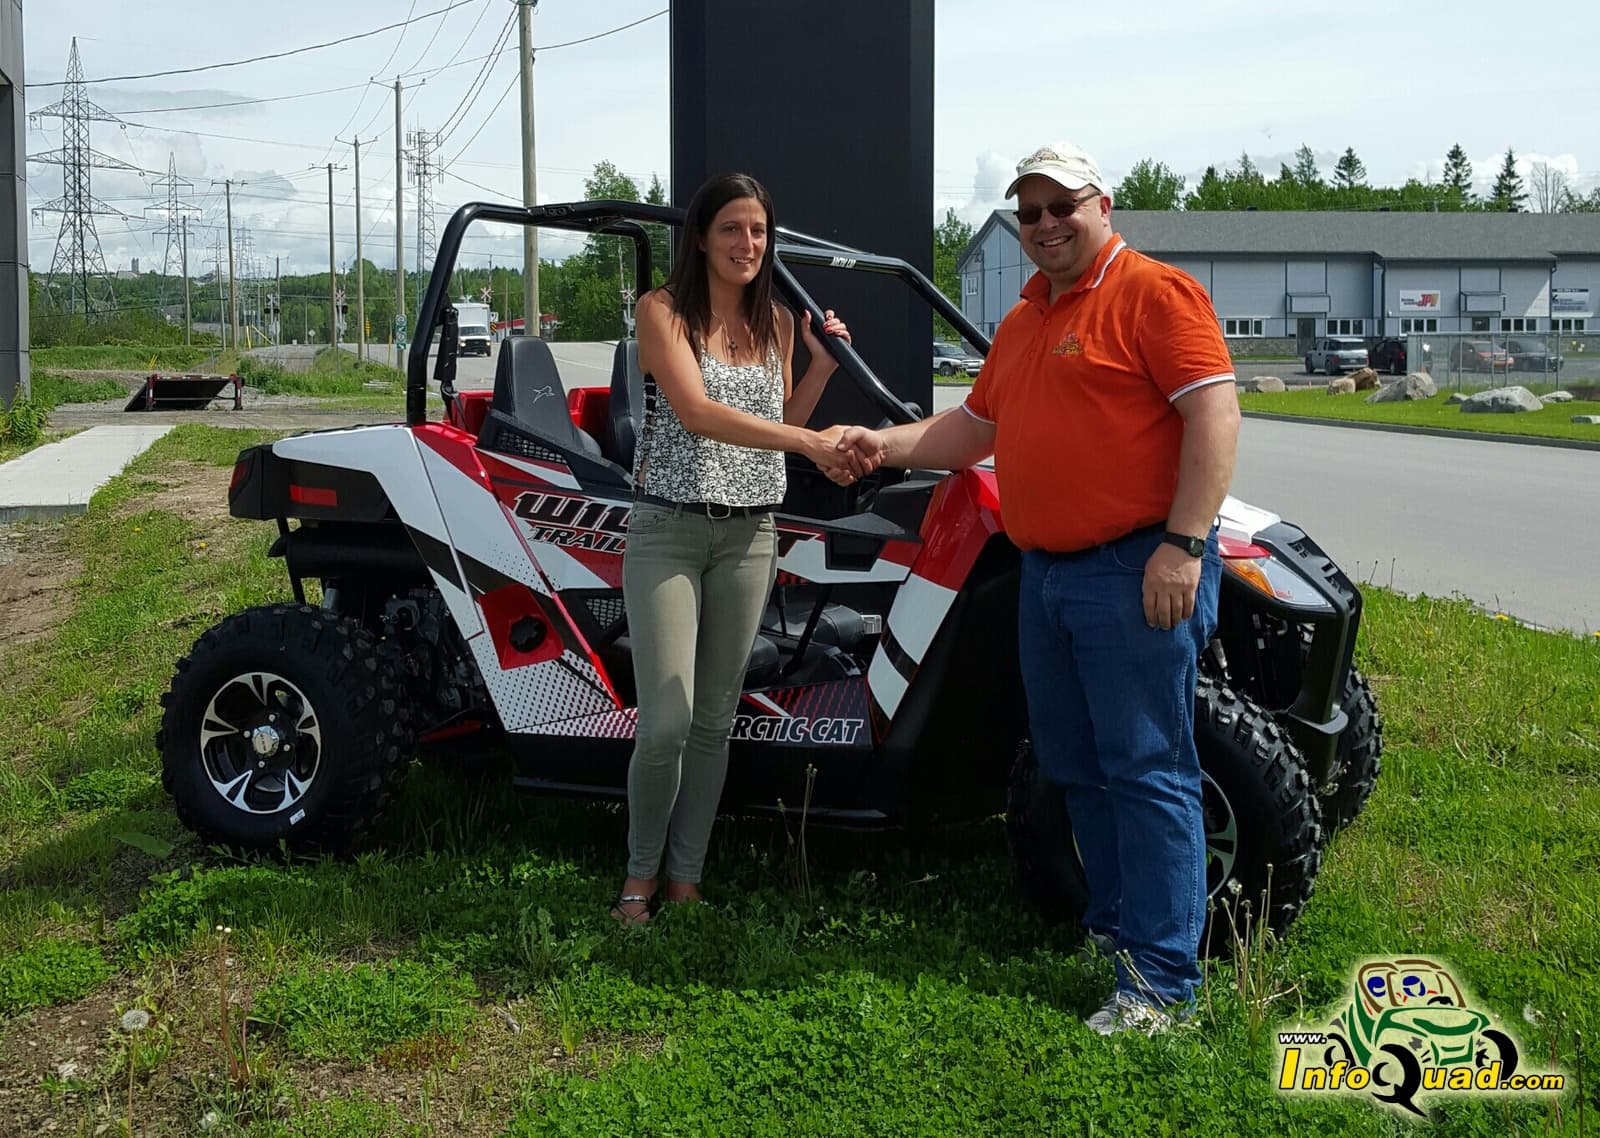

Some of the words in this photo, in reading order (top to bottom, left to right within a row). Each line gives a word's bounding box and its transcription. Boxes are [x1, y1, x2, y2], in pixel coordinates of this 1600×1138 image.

[527, 526, 626, 554] TRAIL
[728, 714, 808, 742] RCTIC
[809, 717, 864, 744] CAT
